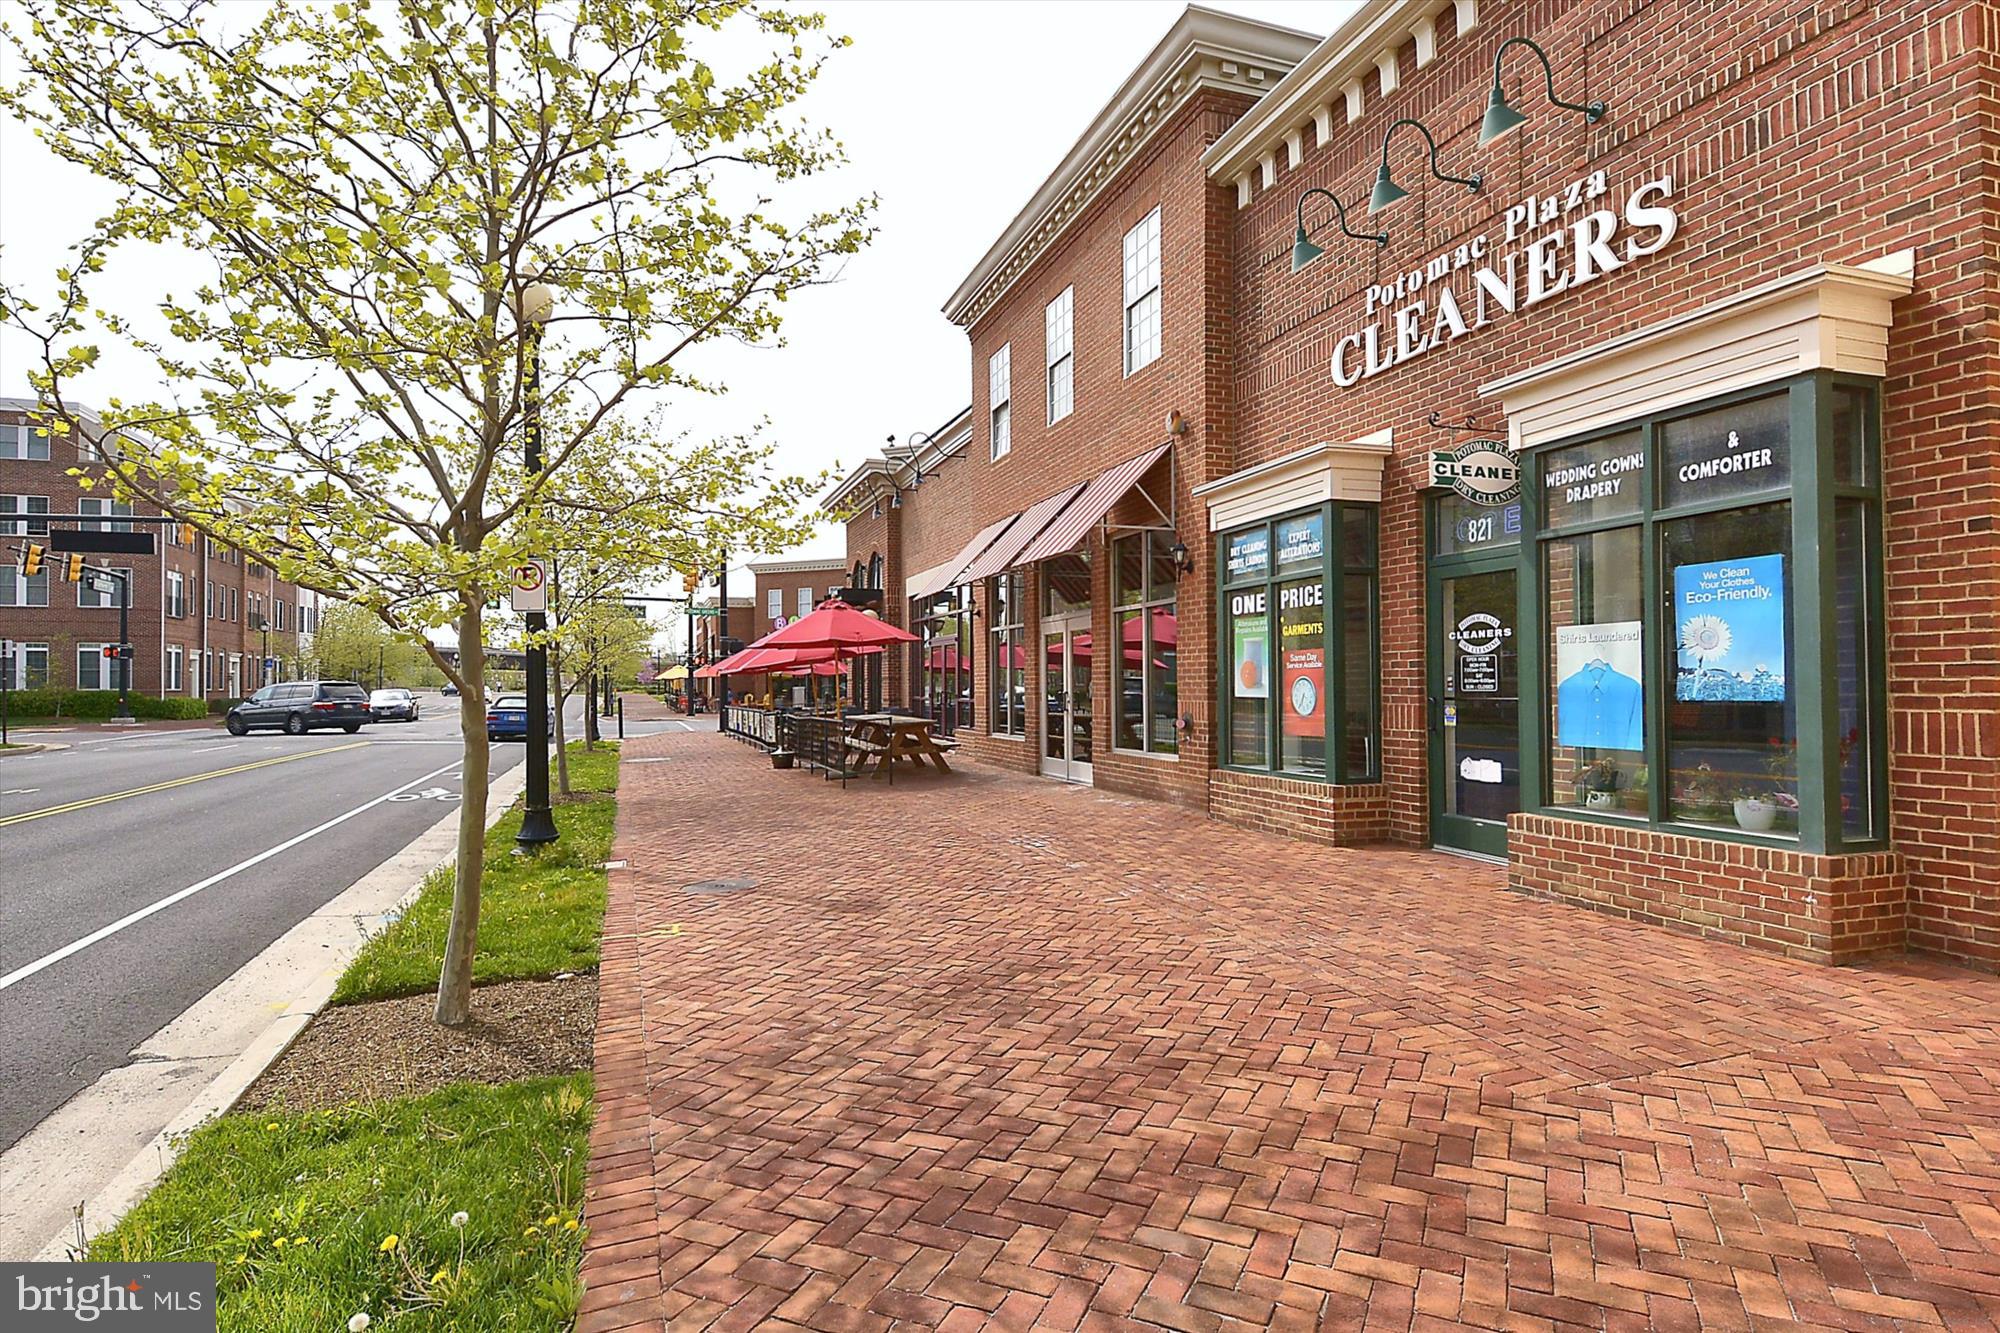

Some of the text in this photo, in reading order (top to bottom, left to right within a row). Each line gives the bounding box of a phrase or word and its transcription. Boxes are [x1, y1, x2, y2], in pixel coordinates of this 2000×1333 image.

[1365, 169, 1608, 315] Potomac Plaza
[1330, 174, 1679, 388] CLEANERS
[1727, 430, 1740, 449] &
[1456, 441, 1493, 461] POTOMAC
[1434, 463, 1521, 481] CLEANE
[1545, 452, 1645, 489] WEDDING GOWNS
[1678, 448, 1773, 483] COMFORTER
[1456, 480, 1474, 497] DRY
[1566, 478, 1622, 504] DRAPERY
[1468, 516, 1493, 543] 821
[1699, 577, 1755, 590] Your Clothes
[1702, 567, 1750, 580] We Clean
[1232, 584, 1324, 616] ONE PRICE
[1685, 584, 1773, 604] Eco-Friendly.
[1282, 622, 1324, 637] GARMENTS
[1448, 628, 1512, 640] CLEANERS
[1560, 629, 1640, 644] Shirts Laundered
